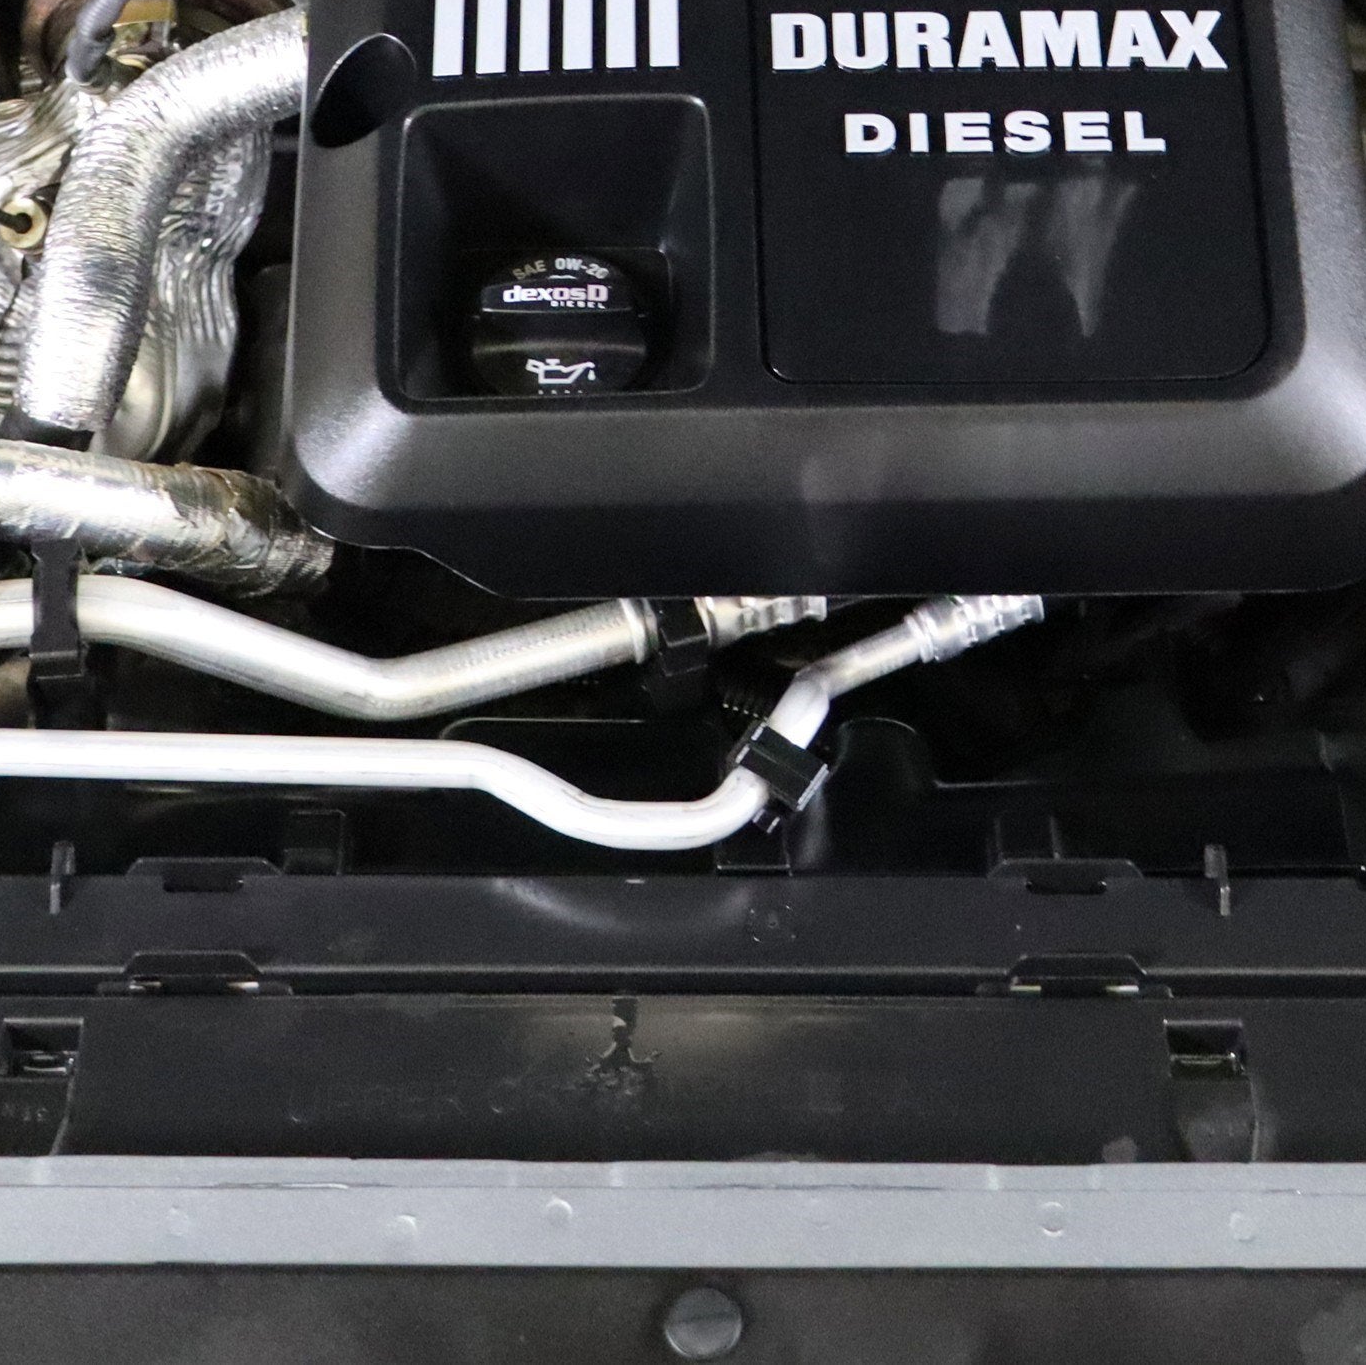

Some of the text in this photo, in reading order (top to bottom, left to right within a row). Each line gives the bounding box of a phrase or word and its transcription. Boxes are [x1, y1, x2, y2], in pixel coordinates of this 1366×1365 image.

[771, 10, 1228, 71] DURAMAX
[845, 109, 1167, 155] DIESEL
[512, 257, 609, 280] SAE 0W-20
[550, 300, 606, 309] DIESEL
